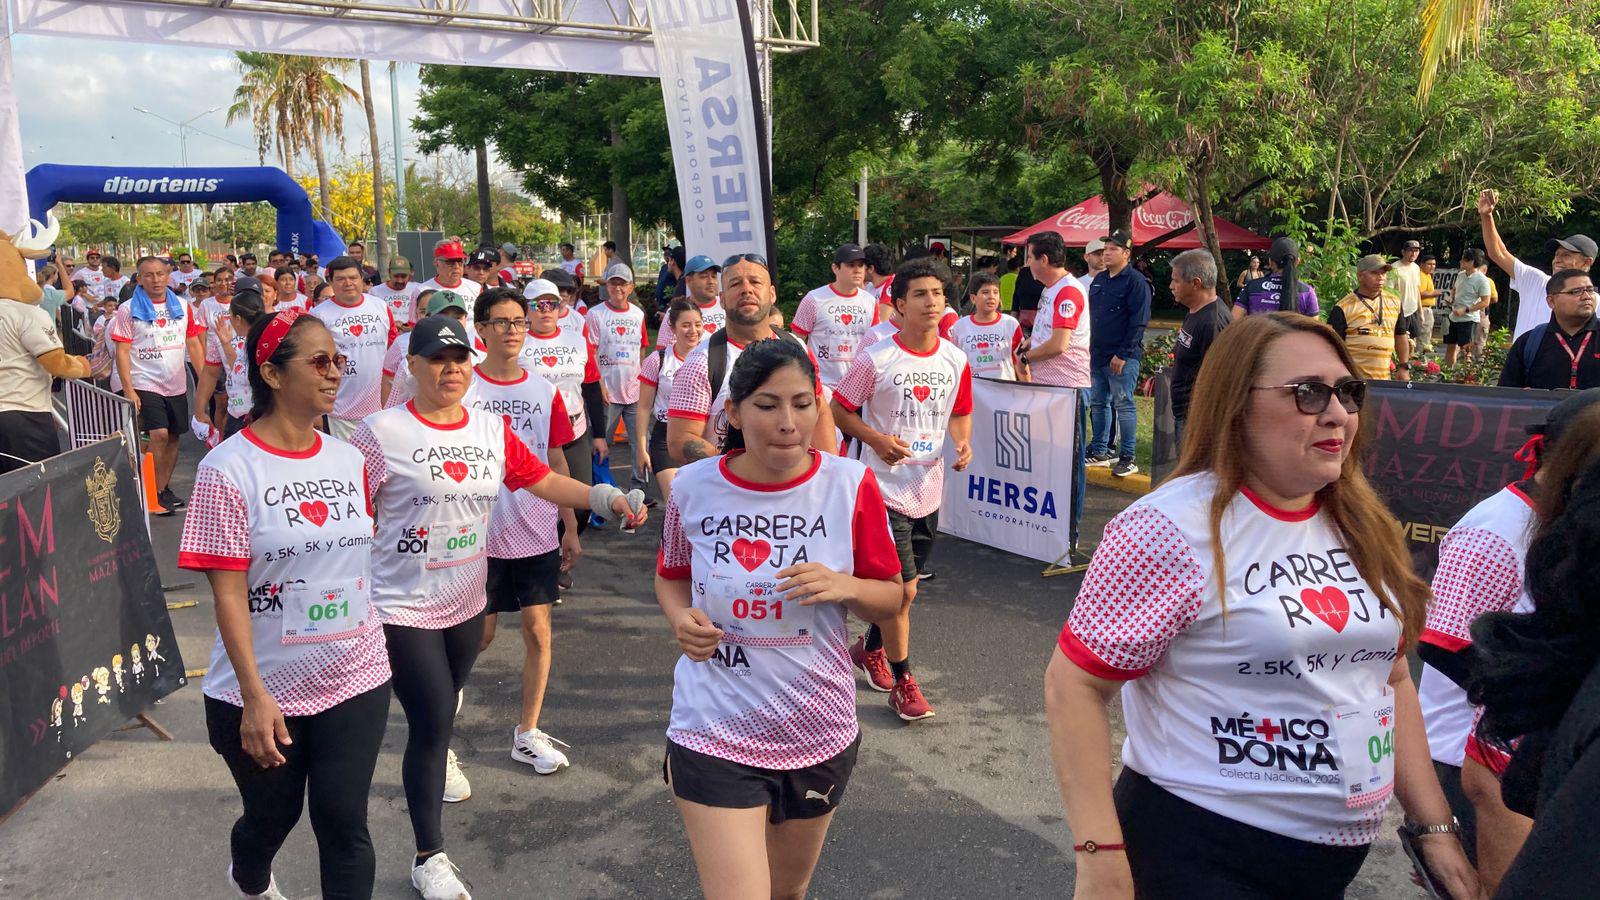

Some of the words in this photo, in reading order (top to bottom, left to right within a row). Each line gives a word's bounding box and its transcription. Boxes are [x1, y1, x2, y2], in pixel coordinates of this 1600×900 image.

[103, 176, 219, 195] dportenis
[334, 314, 382, 328] CARRERA
[524, 346, 578, 358] CARRERA
[893, 371, 953, 387] CARRERA
[411, 445, 497, 464] CARRERA
[911, 440, 934, 453] 054
[263, 478, 360, 507] CARRERA
[444, 493, 458, 503] 5K
[967, 474, 1058, 520] HERSA
[701, 514, 828, 541] CARRERA
[978, 509, 1049, 534] CORPORATIVO
[264, 545, 300, 562] 2.5K,
[305, 540, 321, 553] 5K
[325, 540, 334, 553] y
[446, 532, 477, 551] 060
[1244, 547, 1358, 596] CARRE
[308, 600, 349, 622] 061
[732, 598, 783, 620] 051
[1237, 659, 1302, 680] 2.5K,
[1307, 652, 1328, 673] 5K
[1331, 653, 1346, 672] y
[1214, 736, 1340, 772] DONA
[1219, 767, 1262, 782] Colecta
[1264, 770, 1312, 785] Nacional
[1314, 774, 1341, 785] 2025
